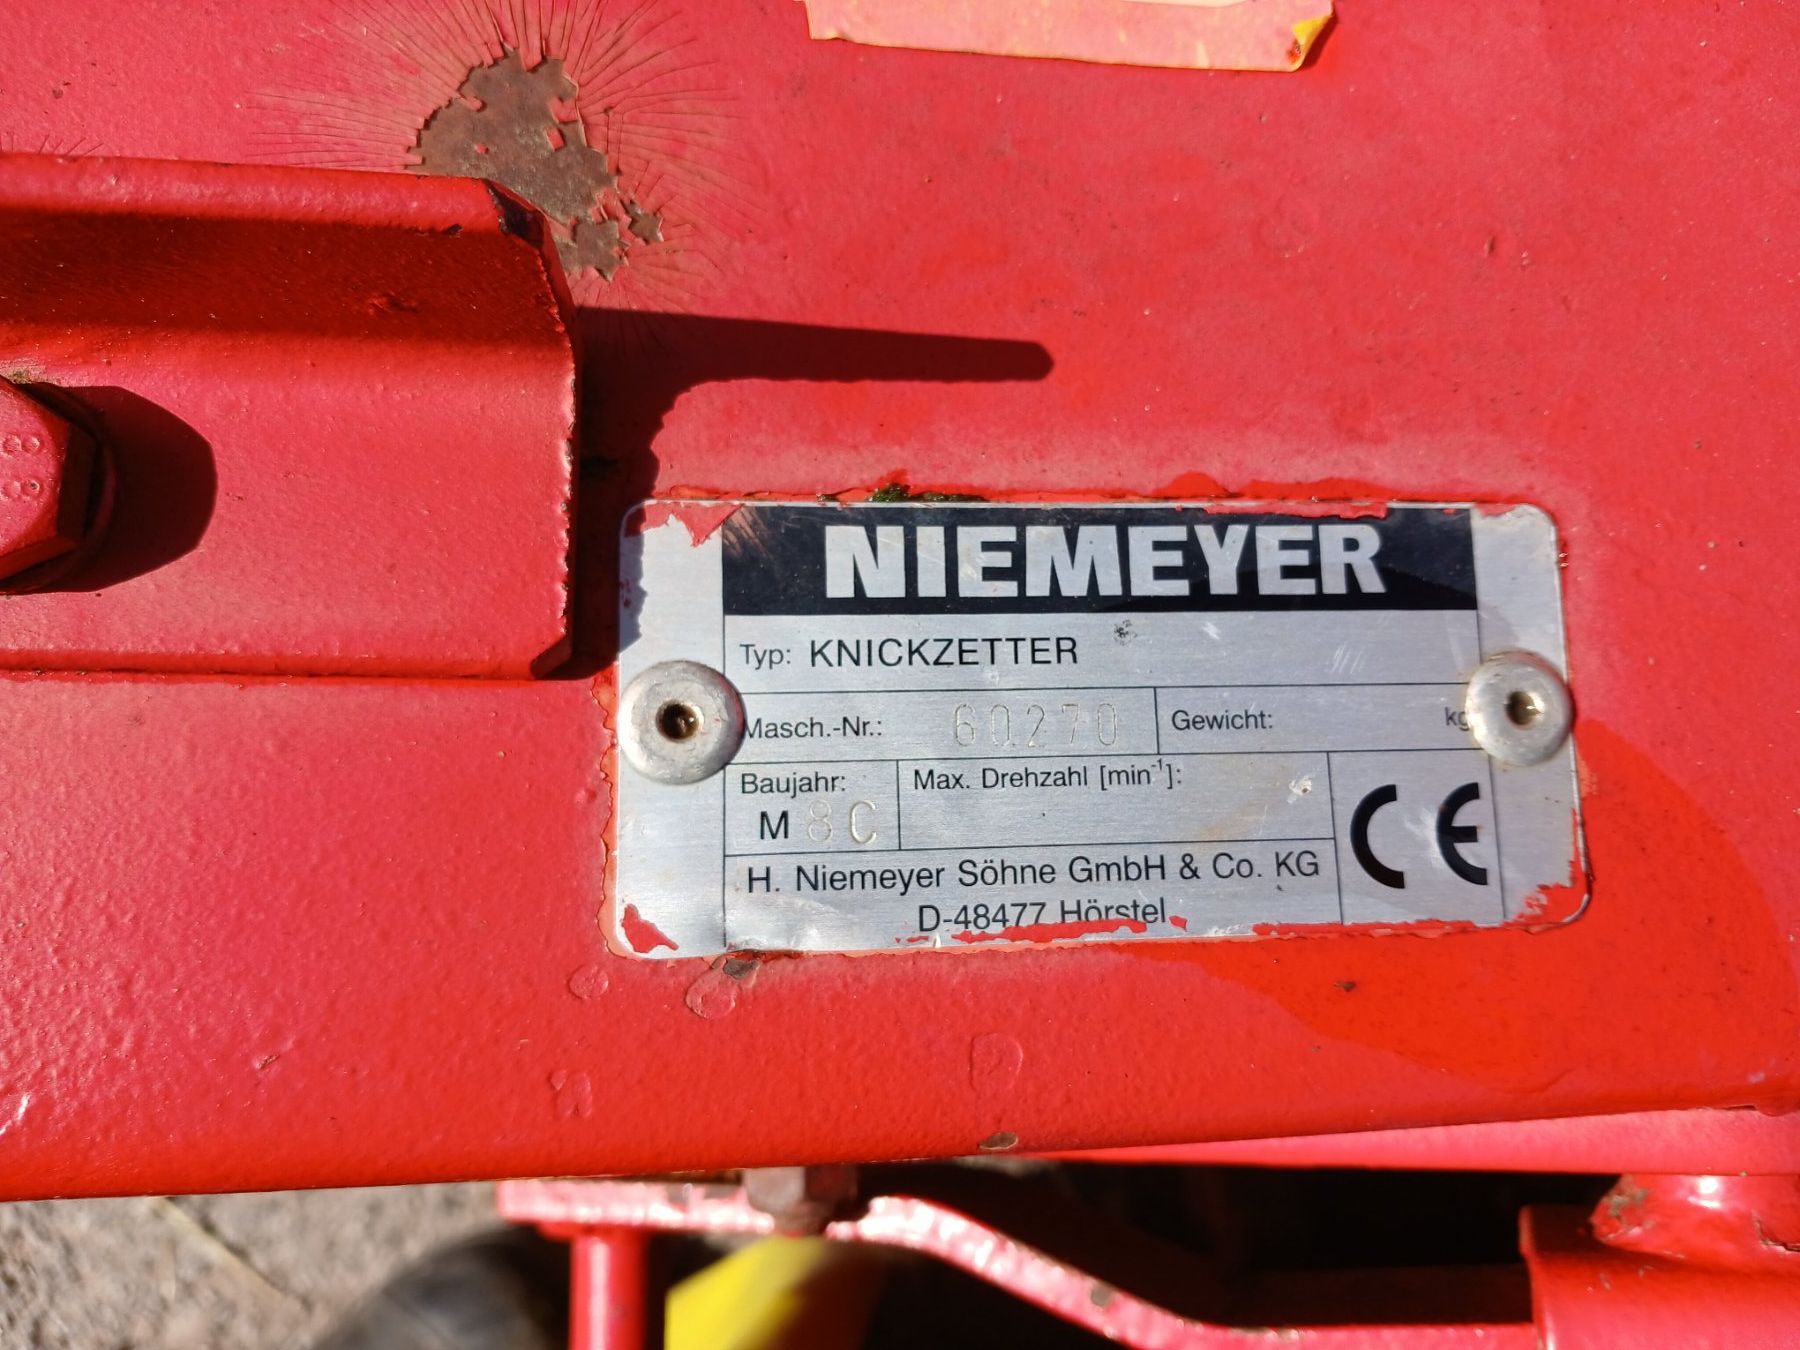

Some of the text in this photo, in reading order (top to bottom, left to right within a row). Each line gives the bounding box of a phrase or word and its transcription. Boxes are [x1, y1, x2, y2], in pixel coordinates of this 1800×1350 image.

[825, 524, 1387, 599] NIEMEYER
[740, 637, 1079, 670] Typ: KNICKZETTER
[745, 702, 1117, 747] Masch.-Nr.: 60270
[1172, 709, 1273, 731] Gewicht:
[741, 772, 846, 799] Baujahr:
[914, 768, 970, 790] Max.
[982, 766, 1088, 788] Drehzahl
[1349, 781, 1488, 889] CE
[748, 851, 1320, 896] H. Niemeyer Söhne GmbH & Co. KG
[918, 897, 1166, 932] D-48477 Hörstel
